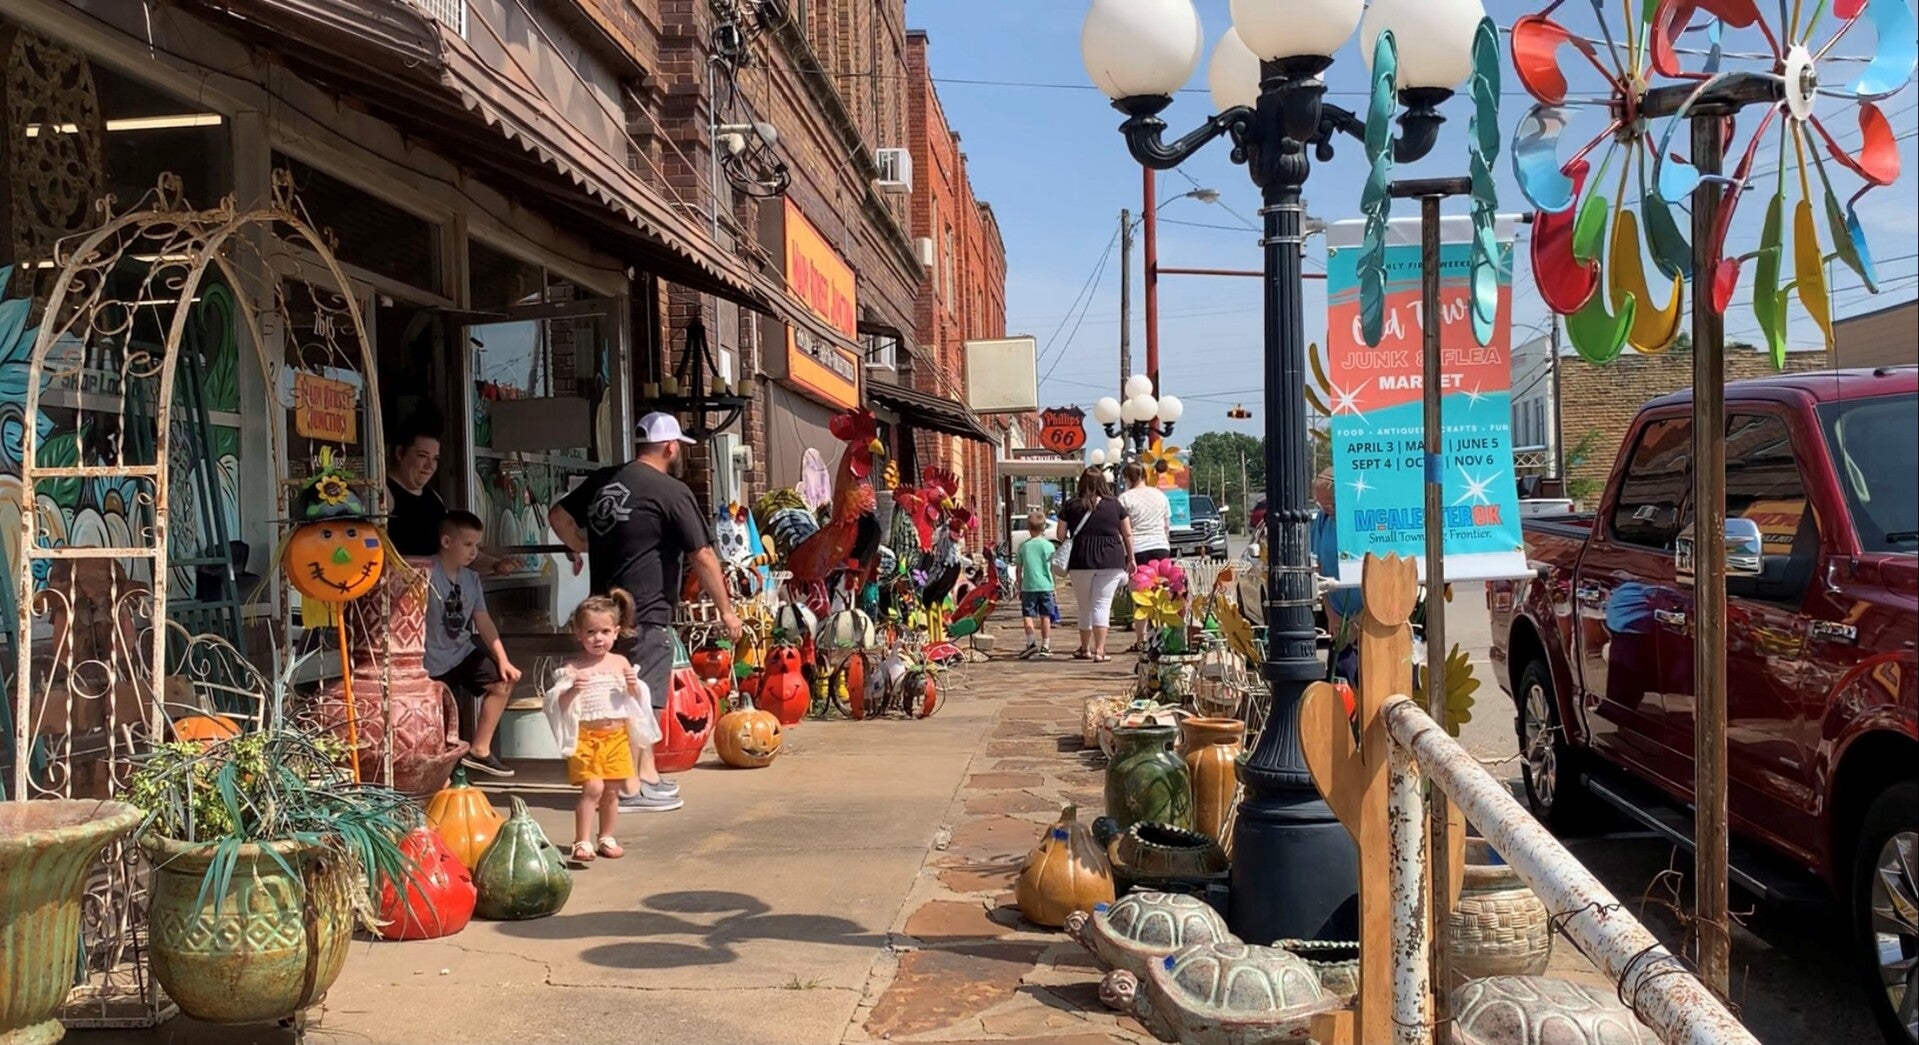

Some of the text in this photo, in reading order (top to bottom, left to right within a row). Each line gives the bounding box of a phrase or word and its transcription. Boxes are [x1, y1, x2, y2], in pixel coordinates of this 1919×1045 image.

[1341, 350, 1409, 370] JUNK
[1441, 347, 1502, 366] FLEA
[1378, 373, 1465, 390] MARET
[1043, 412, 1081, 427] Phillips
[1051, 429, 1076, 446] 66
[1337, 429, 1365, 437] FOOD
[1489, 423, 1509, 432] FUN
[1347, 438, 1499, 454] APRIL 3 MA JUNE 5
[1352, 455, 1494, 470] SEPT 4 OC NOV 6
[1369, 531, 1398, 544] Small
